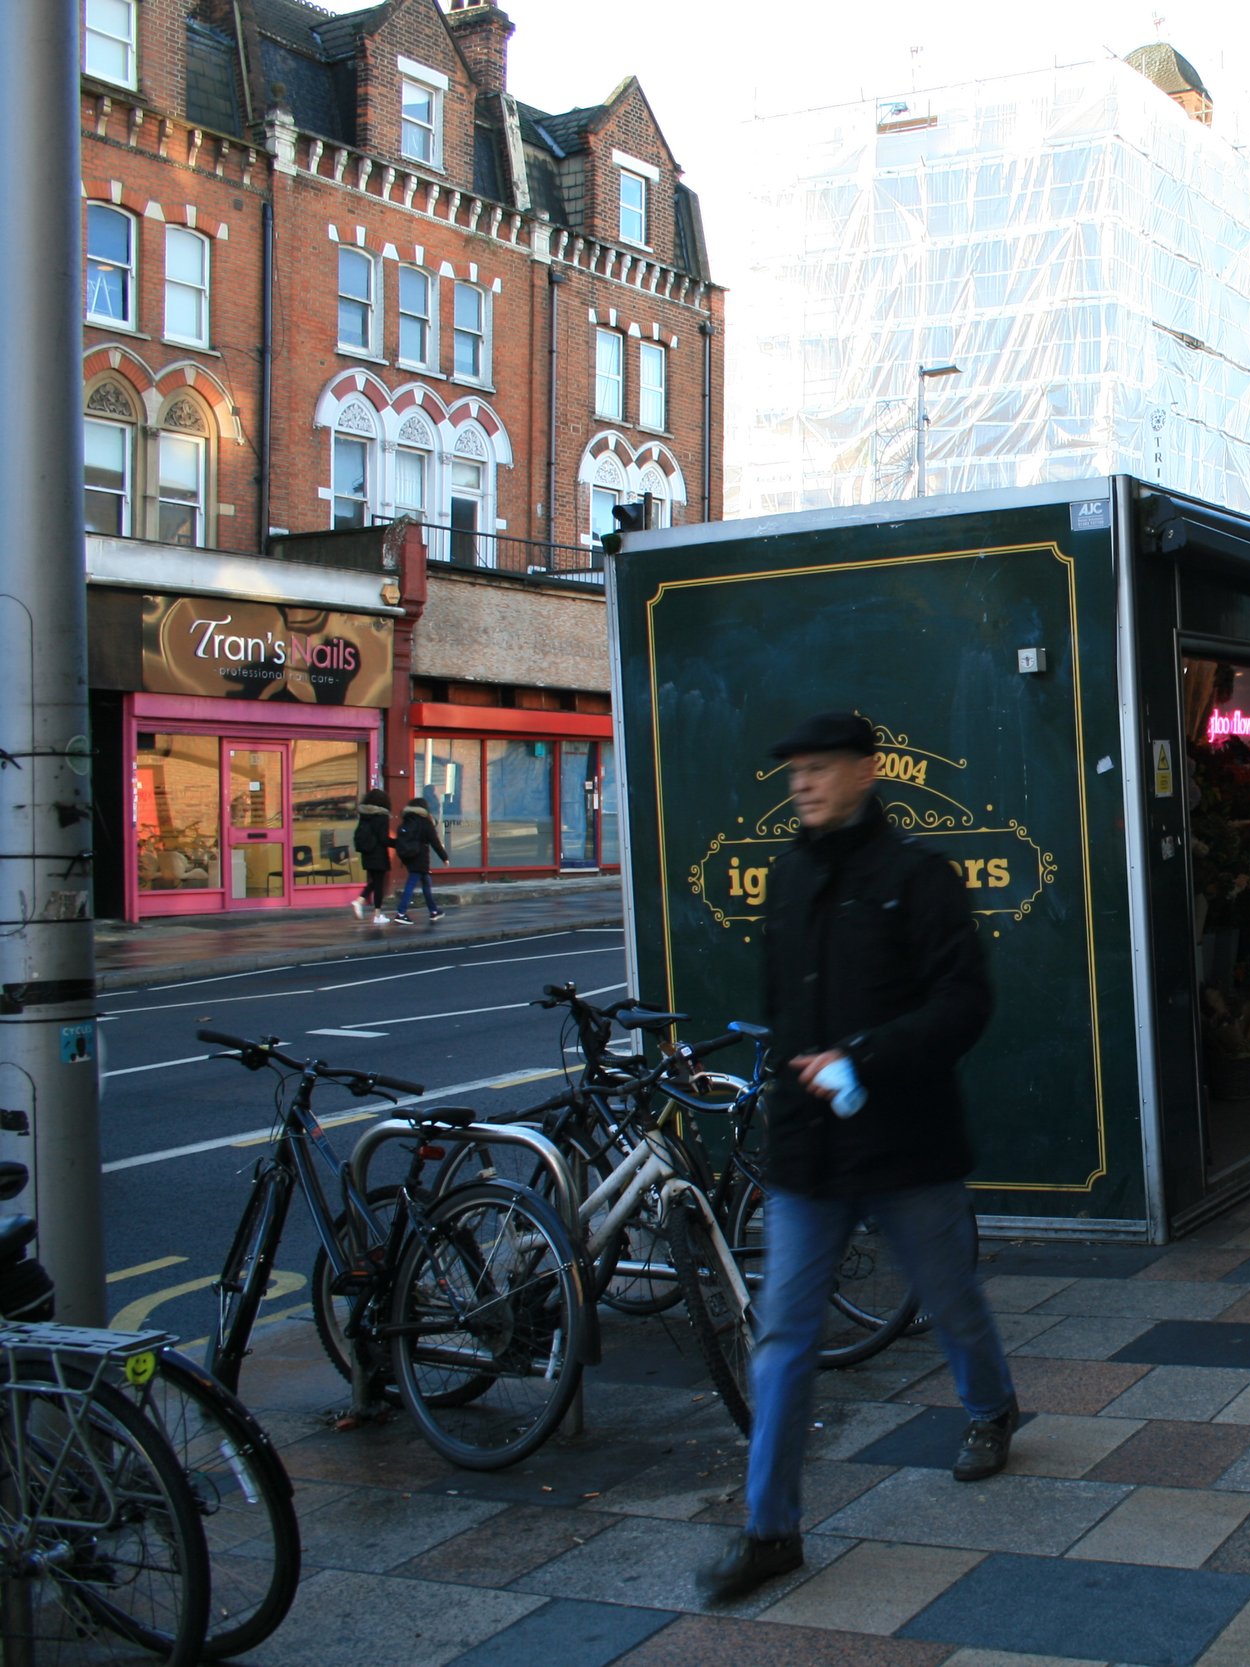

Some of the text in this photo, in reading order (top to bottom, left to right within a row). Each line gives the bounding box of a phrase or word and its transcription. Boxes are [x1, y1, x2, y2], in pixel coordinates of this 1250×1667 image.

[1078, 502, 1103, 516] AJC
[190, 614, 356, 671] Tran's Nails
[873, 752, 928, 785] 2004
